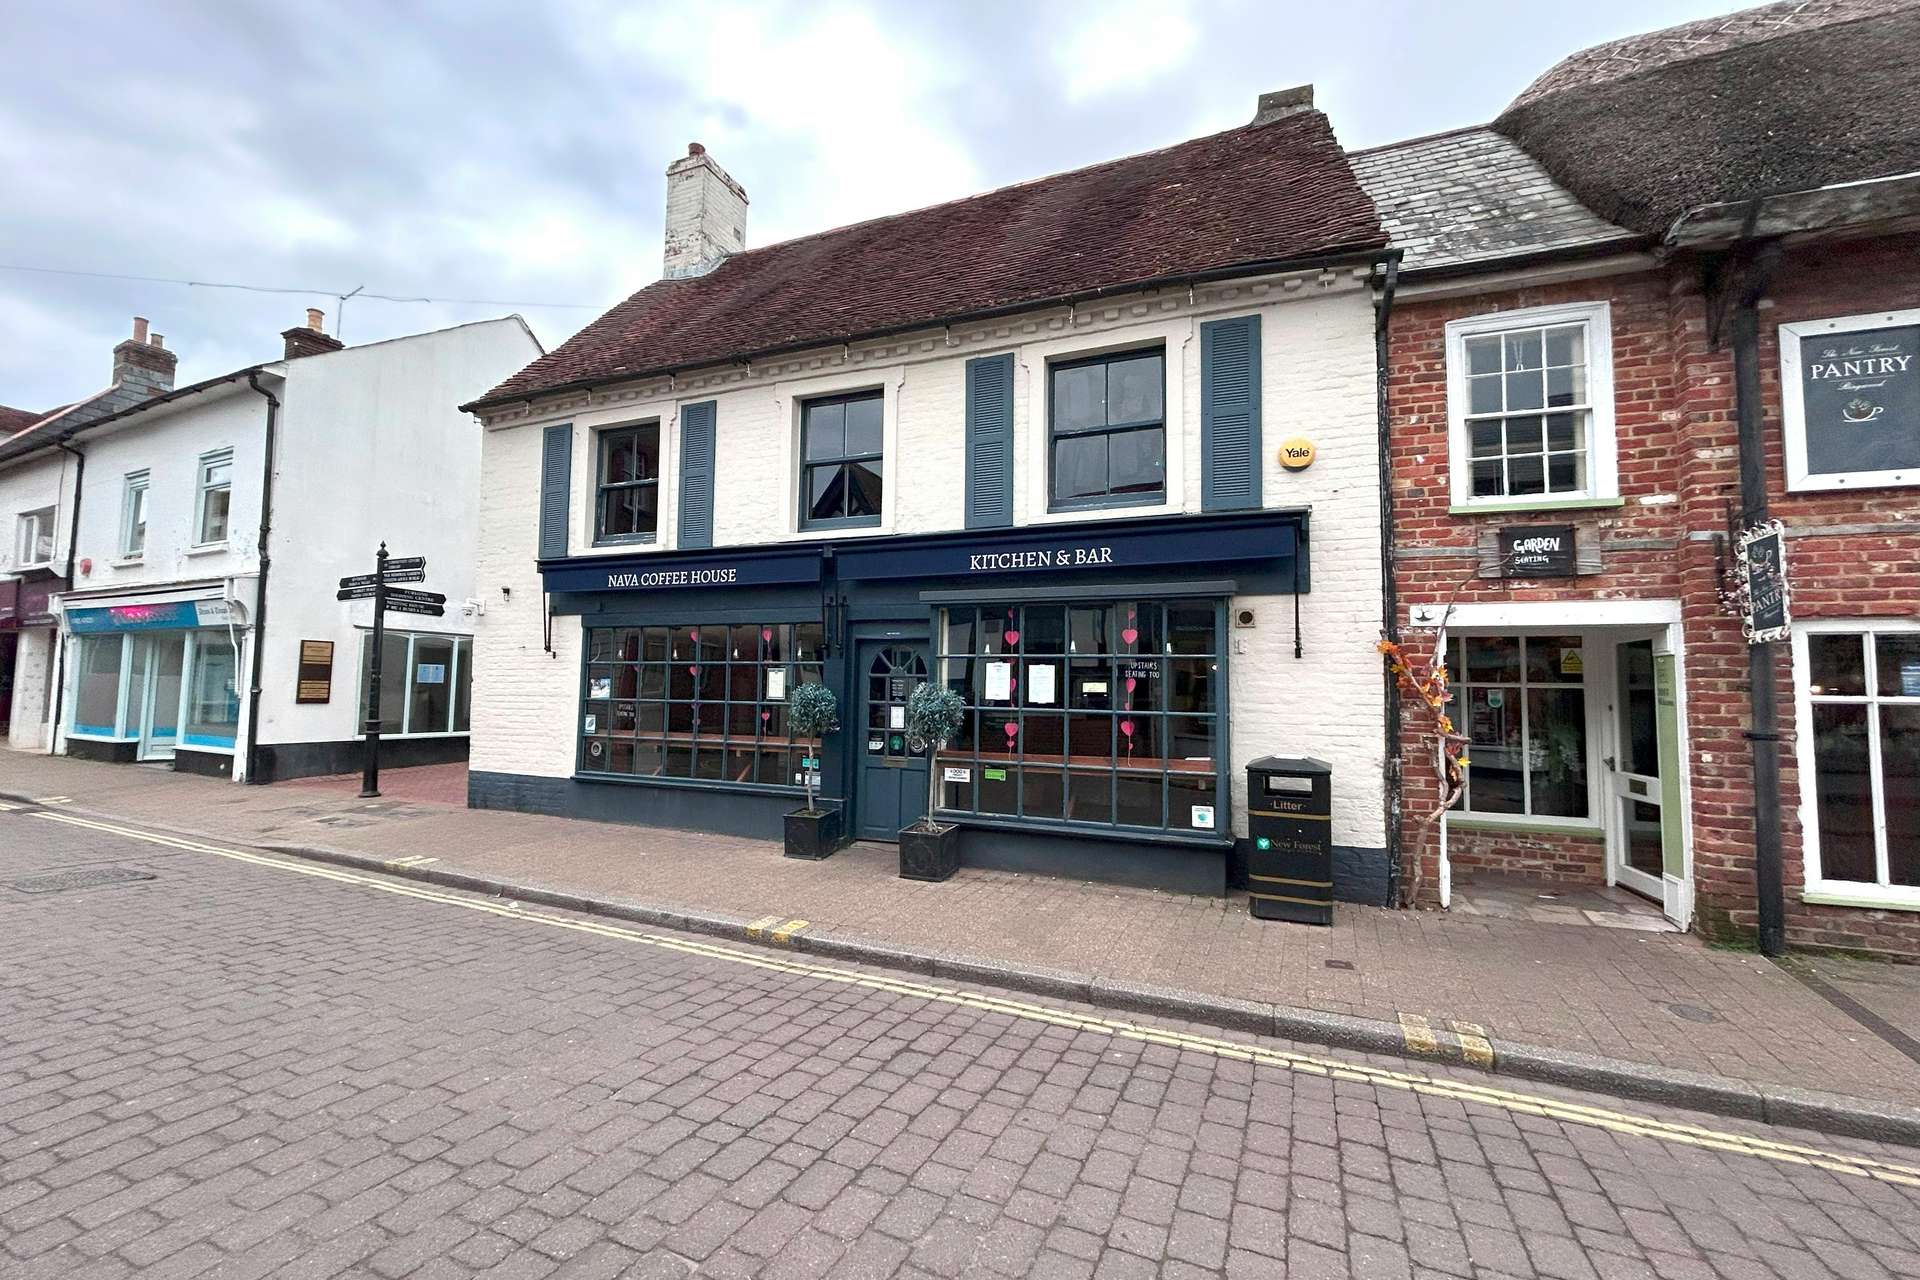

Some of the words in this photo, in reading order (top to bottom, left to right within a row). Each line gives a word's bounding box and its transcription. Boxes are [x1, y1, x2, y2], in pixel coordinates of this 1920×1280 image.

[1810, 355, 1912, 380] PANTRY
[1285, 447, 1310, 458] Yale
[1513, 537, 1560, 554] GARDEN
[969, 550, 1052, 570] KITCHEN
[1055, 549, 1071, 566] &
[1074, 547, 1113, 565] BAR
[607, 574, 639, 588] NAVA
[640, 571, 688, 586] COFFEE
[690, 568, 737, 584] HOUSE
[1125, 670, 1147, 678] SEATING
[1149, 671, 1160, 679] TOO
[1273, 800, 1303, 811] Litter
[1270, 839, 1291, 849] New
